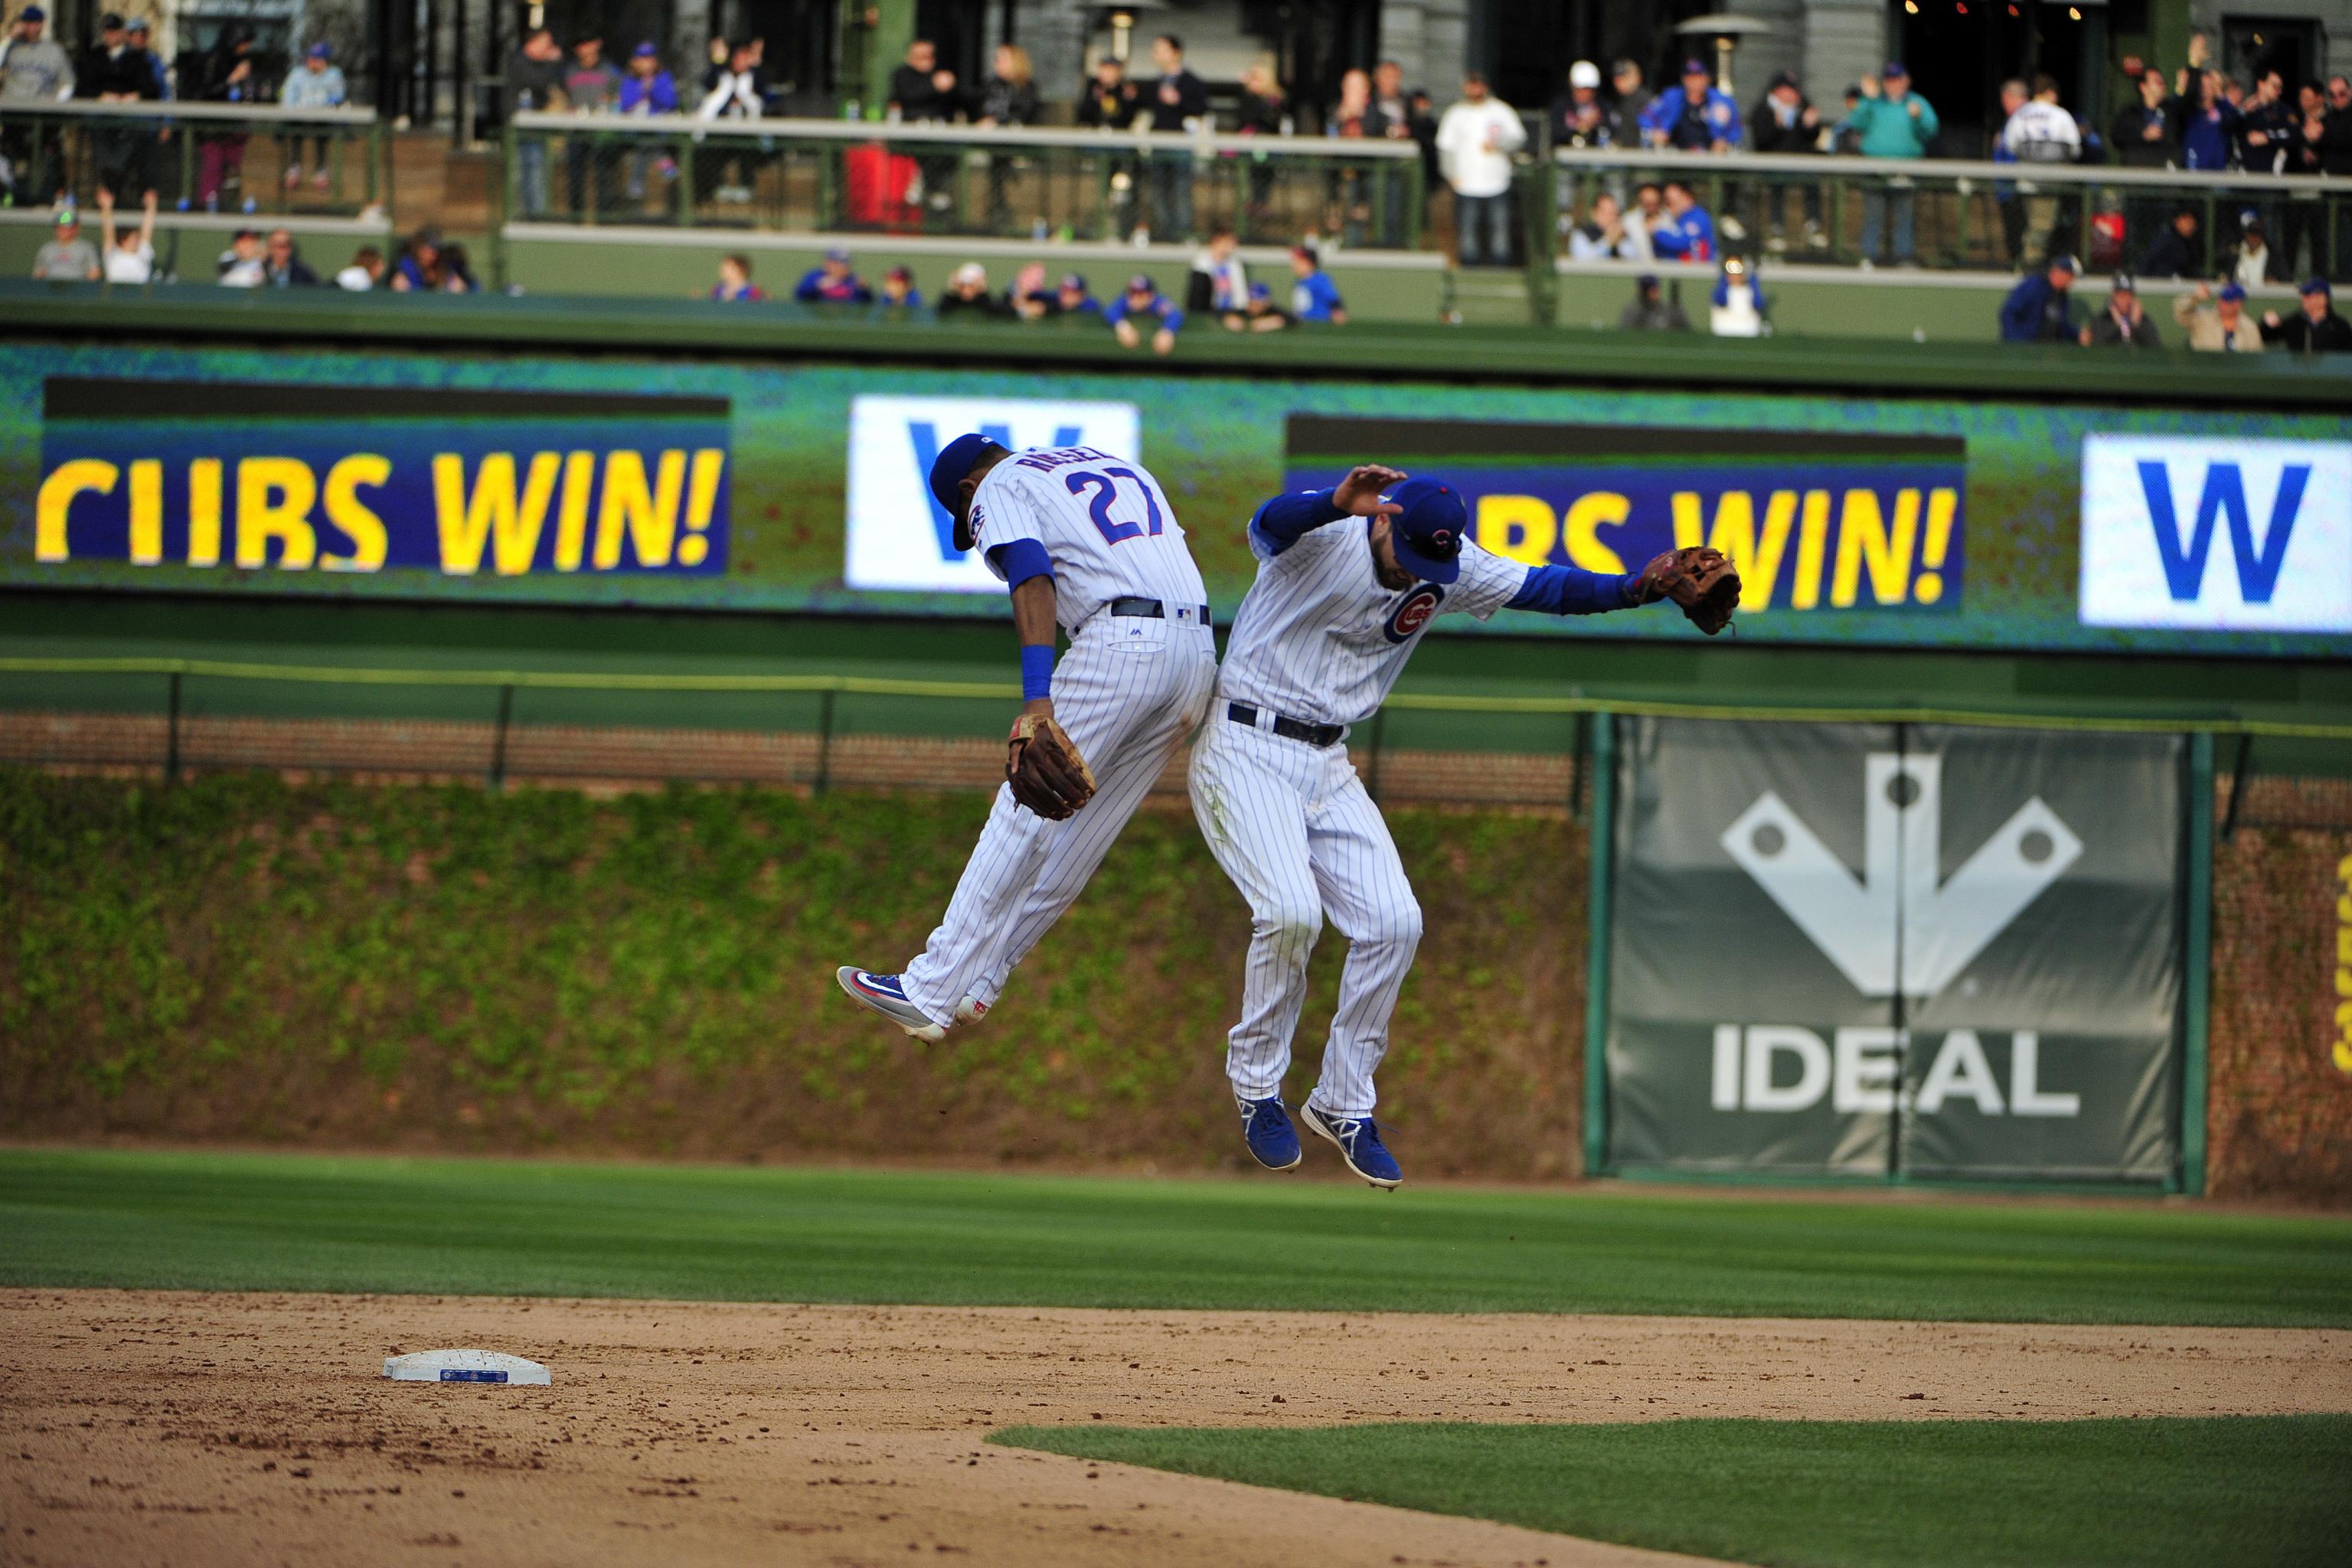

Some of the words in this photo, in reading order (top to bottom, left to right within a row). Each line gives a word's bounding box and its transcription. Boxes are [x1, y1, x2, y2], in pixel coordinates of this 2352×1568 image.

[432, 449, 724, 576] WIN!
[1065, 467, 1163, 546] 27
[1476, 491, 1632, 574] BS
[1671, 488, 1958, 612] WIN!
[2135, 461, 2313, 603] W
[1711, 1024, 2080, 1117] IDEAL
